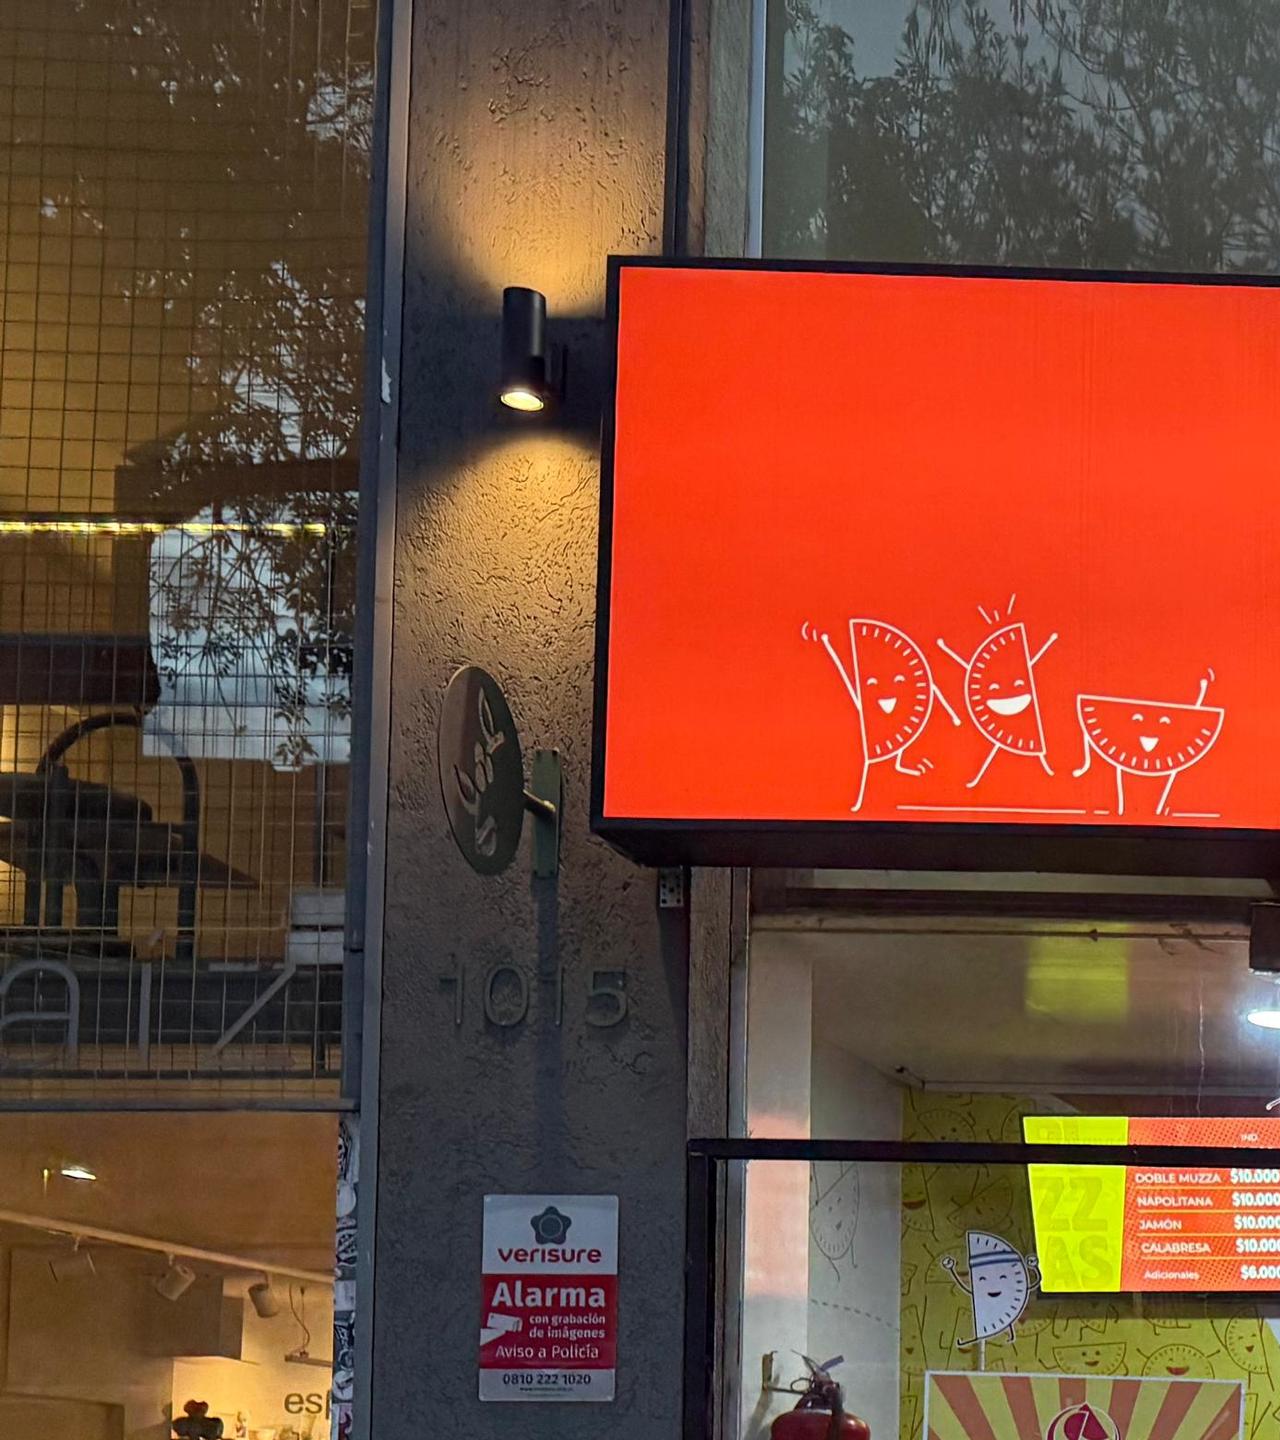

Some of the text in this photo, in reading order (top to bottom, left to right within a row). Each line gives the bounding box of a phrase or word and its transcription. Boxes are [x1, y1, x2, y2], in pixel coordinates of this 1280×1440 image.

[438, 962, 629, 1028] 1015
[1135, 1172, 1176, 1184] DOBLE
[1178, 1173, 1221, 1185] MUZZA
[1230, 1168, 1280, 1184] $10.000
[1137, 1195, 1213, 1207] NAPOLITANA
[1139, 1217, 1182, 1230] JAMÓN
[497, 1247, 602, 1263] verisure
[1141, 1242, 1211, 1254] CALABRESA
[1144, 1269, 1200, 1280] Adicionales
[491, 1280, 606, 1308] Alarma
[529, 1313, 606, 1327] con grabación
[529, 1326, 606, 1341] de imágenes
[495, 1343, 599, 1359] Aviso a Policía
[503, 1373, 591, 1385] 0810 222 1020
